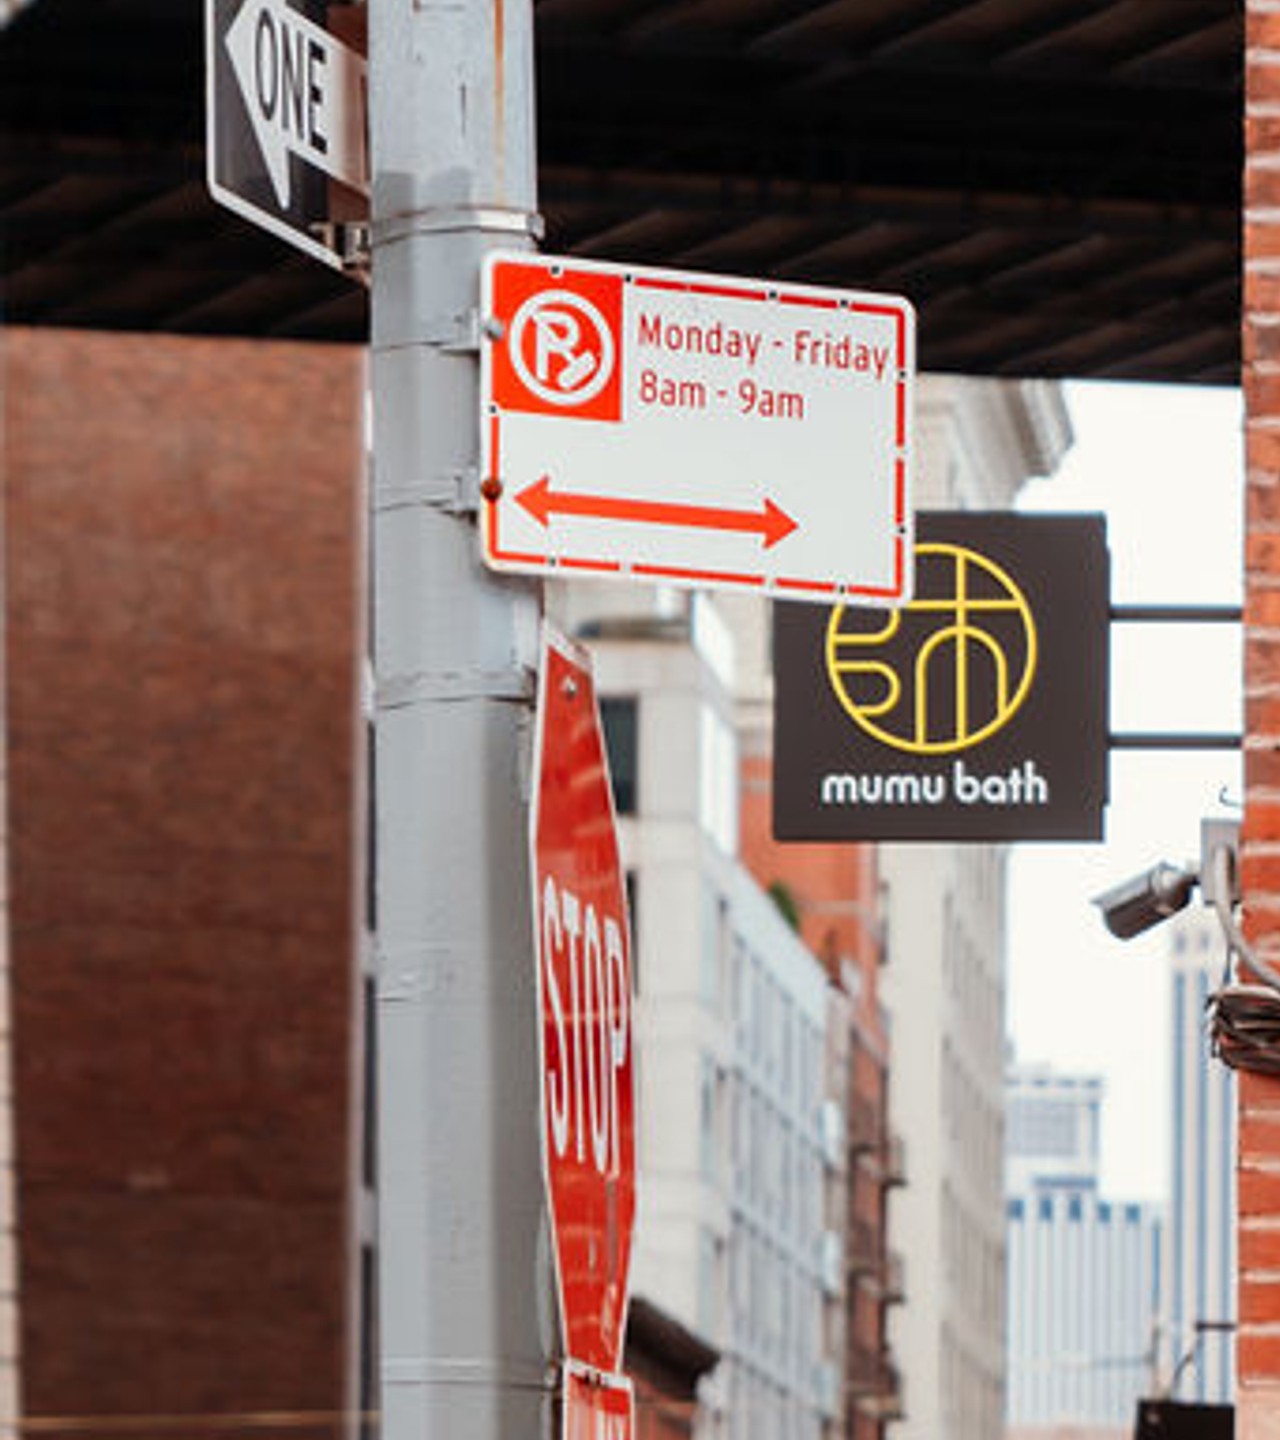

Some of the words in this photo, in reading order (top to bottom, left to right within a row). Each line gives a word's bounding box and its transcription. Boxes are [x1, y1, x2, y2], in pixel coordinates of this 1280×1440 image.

[255, 6, 328, 155] ONE
[638, 313, 762, 367] Monday
[795, 330, 890, 380] Friday
[640, 370, 706, 409] 8am
[739, 379, 804, 420] 9am
[822, 773, 945, 804] mumu
[954, 760, 1049, 804] bath
[544, 875, 627, 1179] STOP
